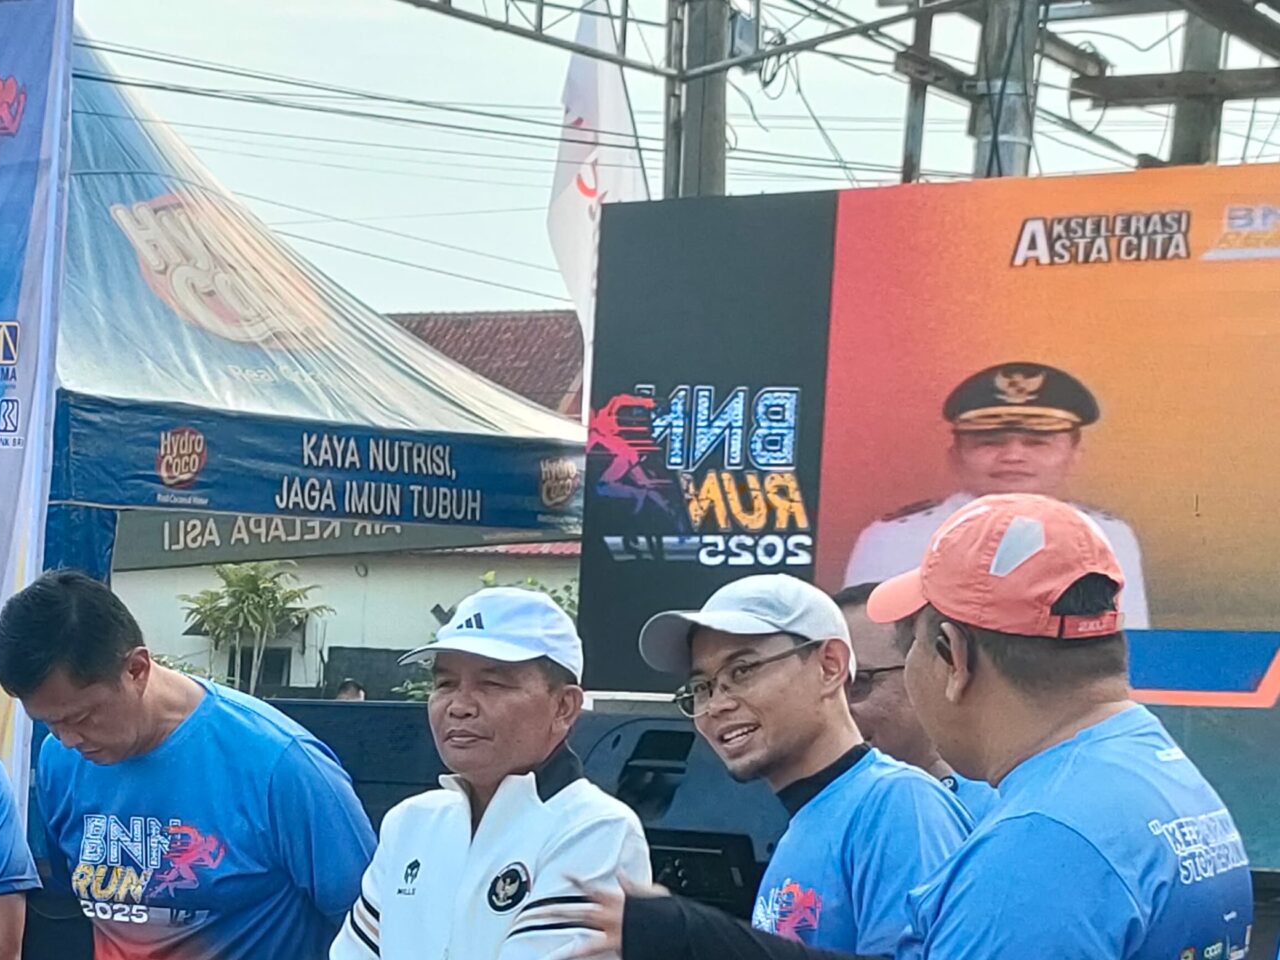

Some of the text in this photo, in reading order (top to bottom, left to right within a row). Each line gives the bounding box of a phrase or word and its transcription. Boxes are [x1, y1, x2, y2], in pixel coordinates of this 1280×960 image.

[1120, 233, 1188, 261] CITA
[160, 430, 204, 458] Hydro
[302, 432, 457, 480] KAYA NUTRISI,
[160, 454, 200, 485] Coco
[275, 476, 481, 521] JAGA IMUN TUBUH
[71, 864, 154, 904] RUN
[79, 900, 150, 924] 2025
